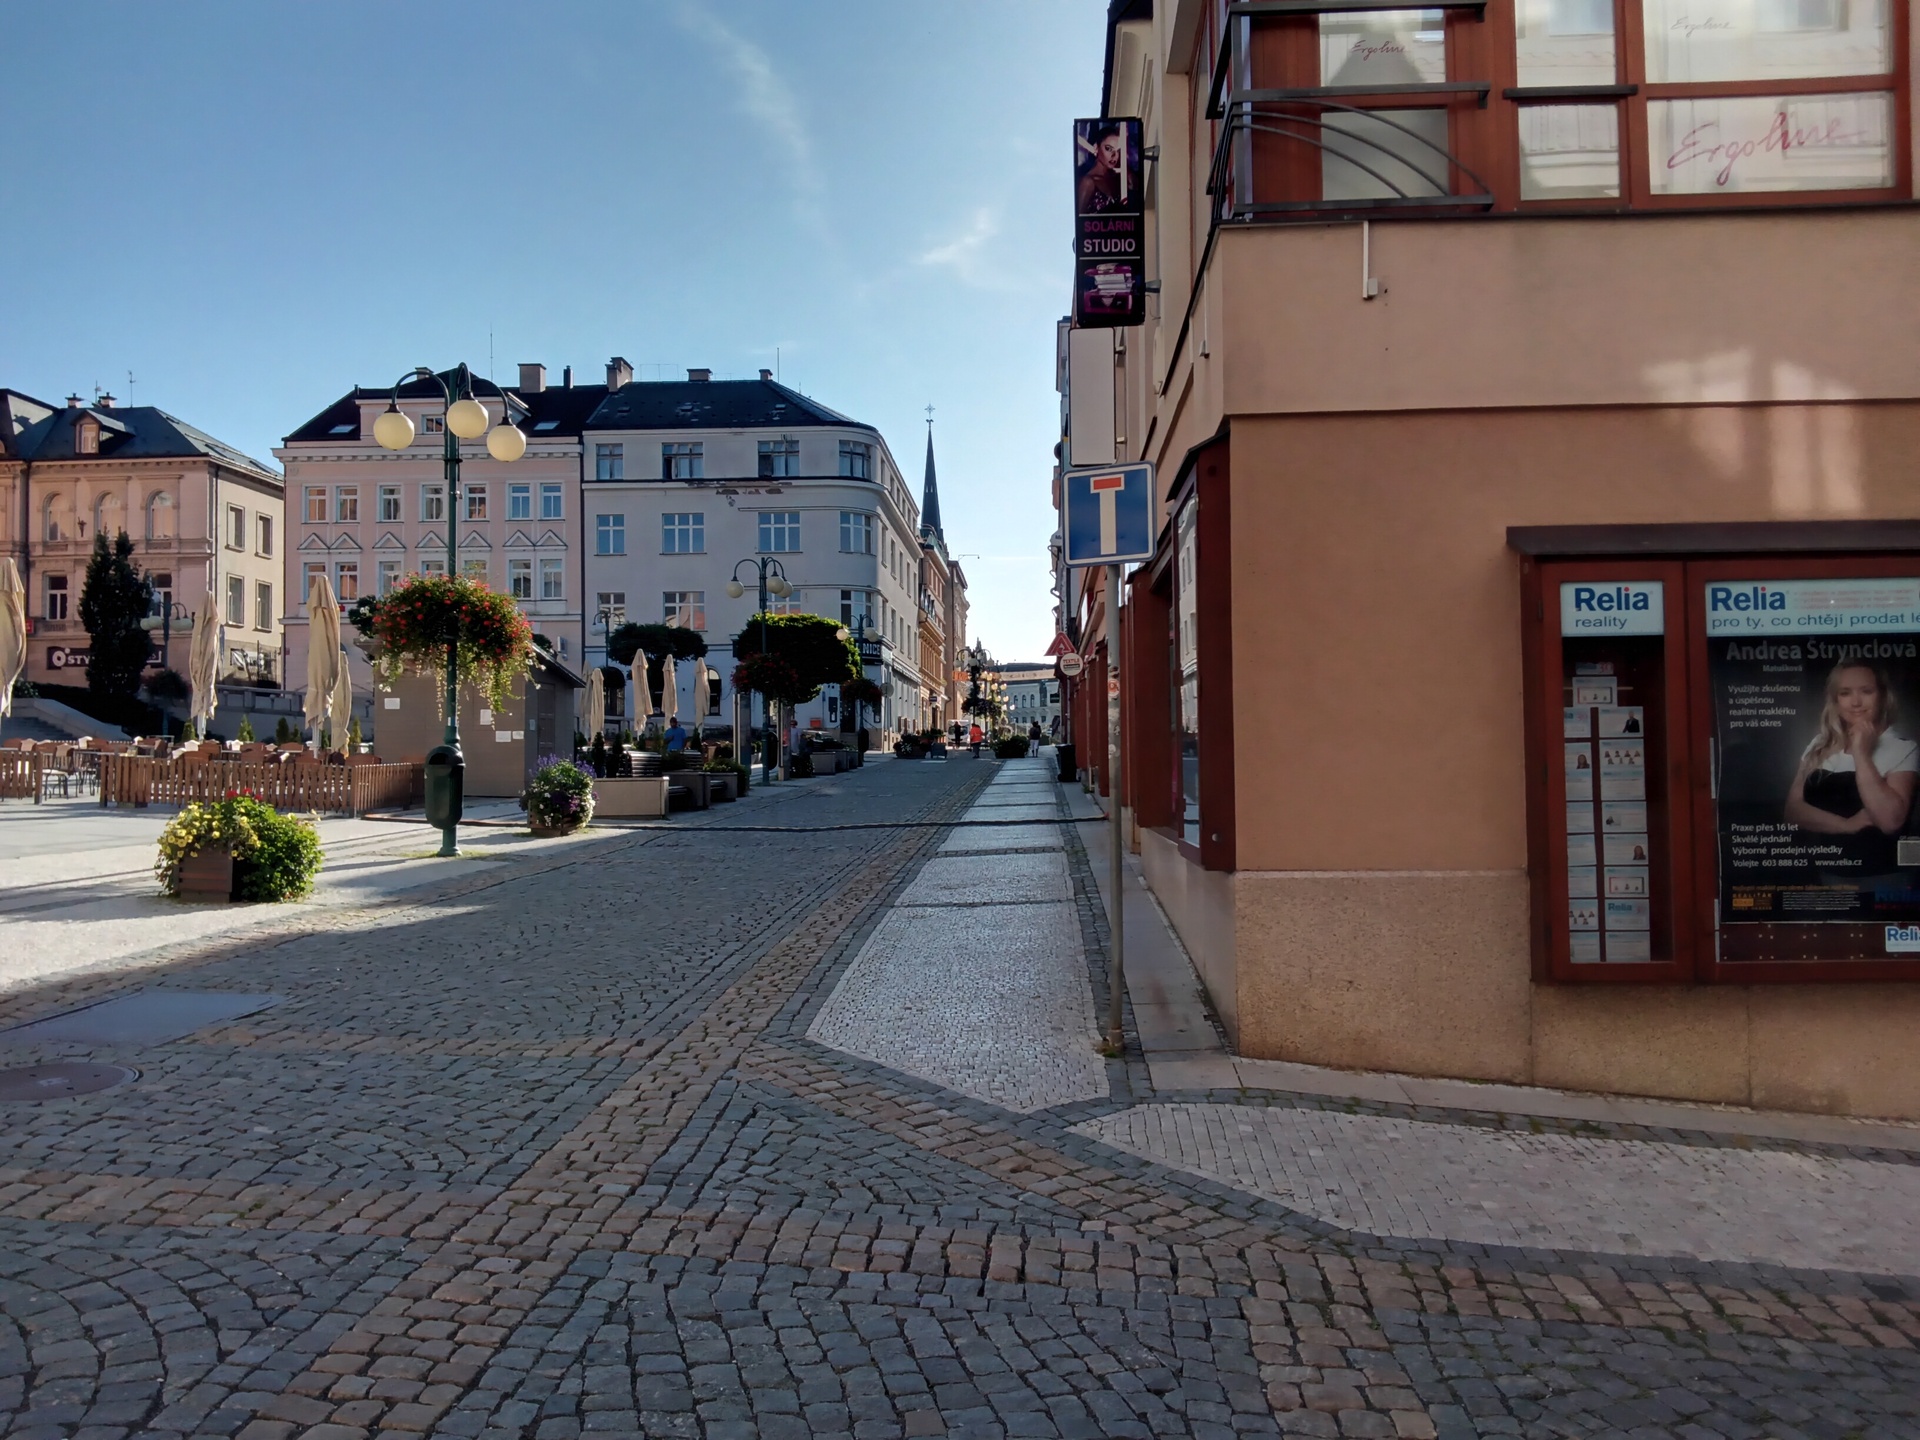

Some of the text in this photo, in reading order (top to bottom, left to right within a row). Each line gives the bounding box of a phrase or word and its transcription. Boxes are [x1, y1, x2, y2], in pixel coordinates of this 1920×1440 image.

[1084, 218, 1135, 232] SOLÁRNÍ
[1083, 238, 1136, 253] STUDIO
[1575, 586, 1649, 612] Relia
[1711, 586, 1786, 611] Relia
[1575, 616, 1628, 630] reality
[1712, 617, 1740, 630] pro
[1746, 616, 1764, 629] ty,
[1771, 617, 1791, 626] co
[1797, 613, 1844, 628] chtějí
[1850, 612, 1905, 627] prodat
[1726, 636, 1917, 664] Andrea Štrynclová
[1728, 683, 1800, 694] Využijte zkušenou
[1730, 718, 1782, 729] pro váš okres
[1731, 823, 1755, 831] Praxe
[1755, 823, 1774, 833] přes
[1787, 823, 1799, 831] let
[1759, 834, 1792, 844] jednání
[1732, 845, 1843, 856] Výborné prodejní výsledky
[1733, 859, 1759, 868] Volejte
[1762, 859, 1777, 867] 603
[1793, 858, 1808, 866] 625
[1814, 858, 1863, 866] www.relia.cz
